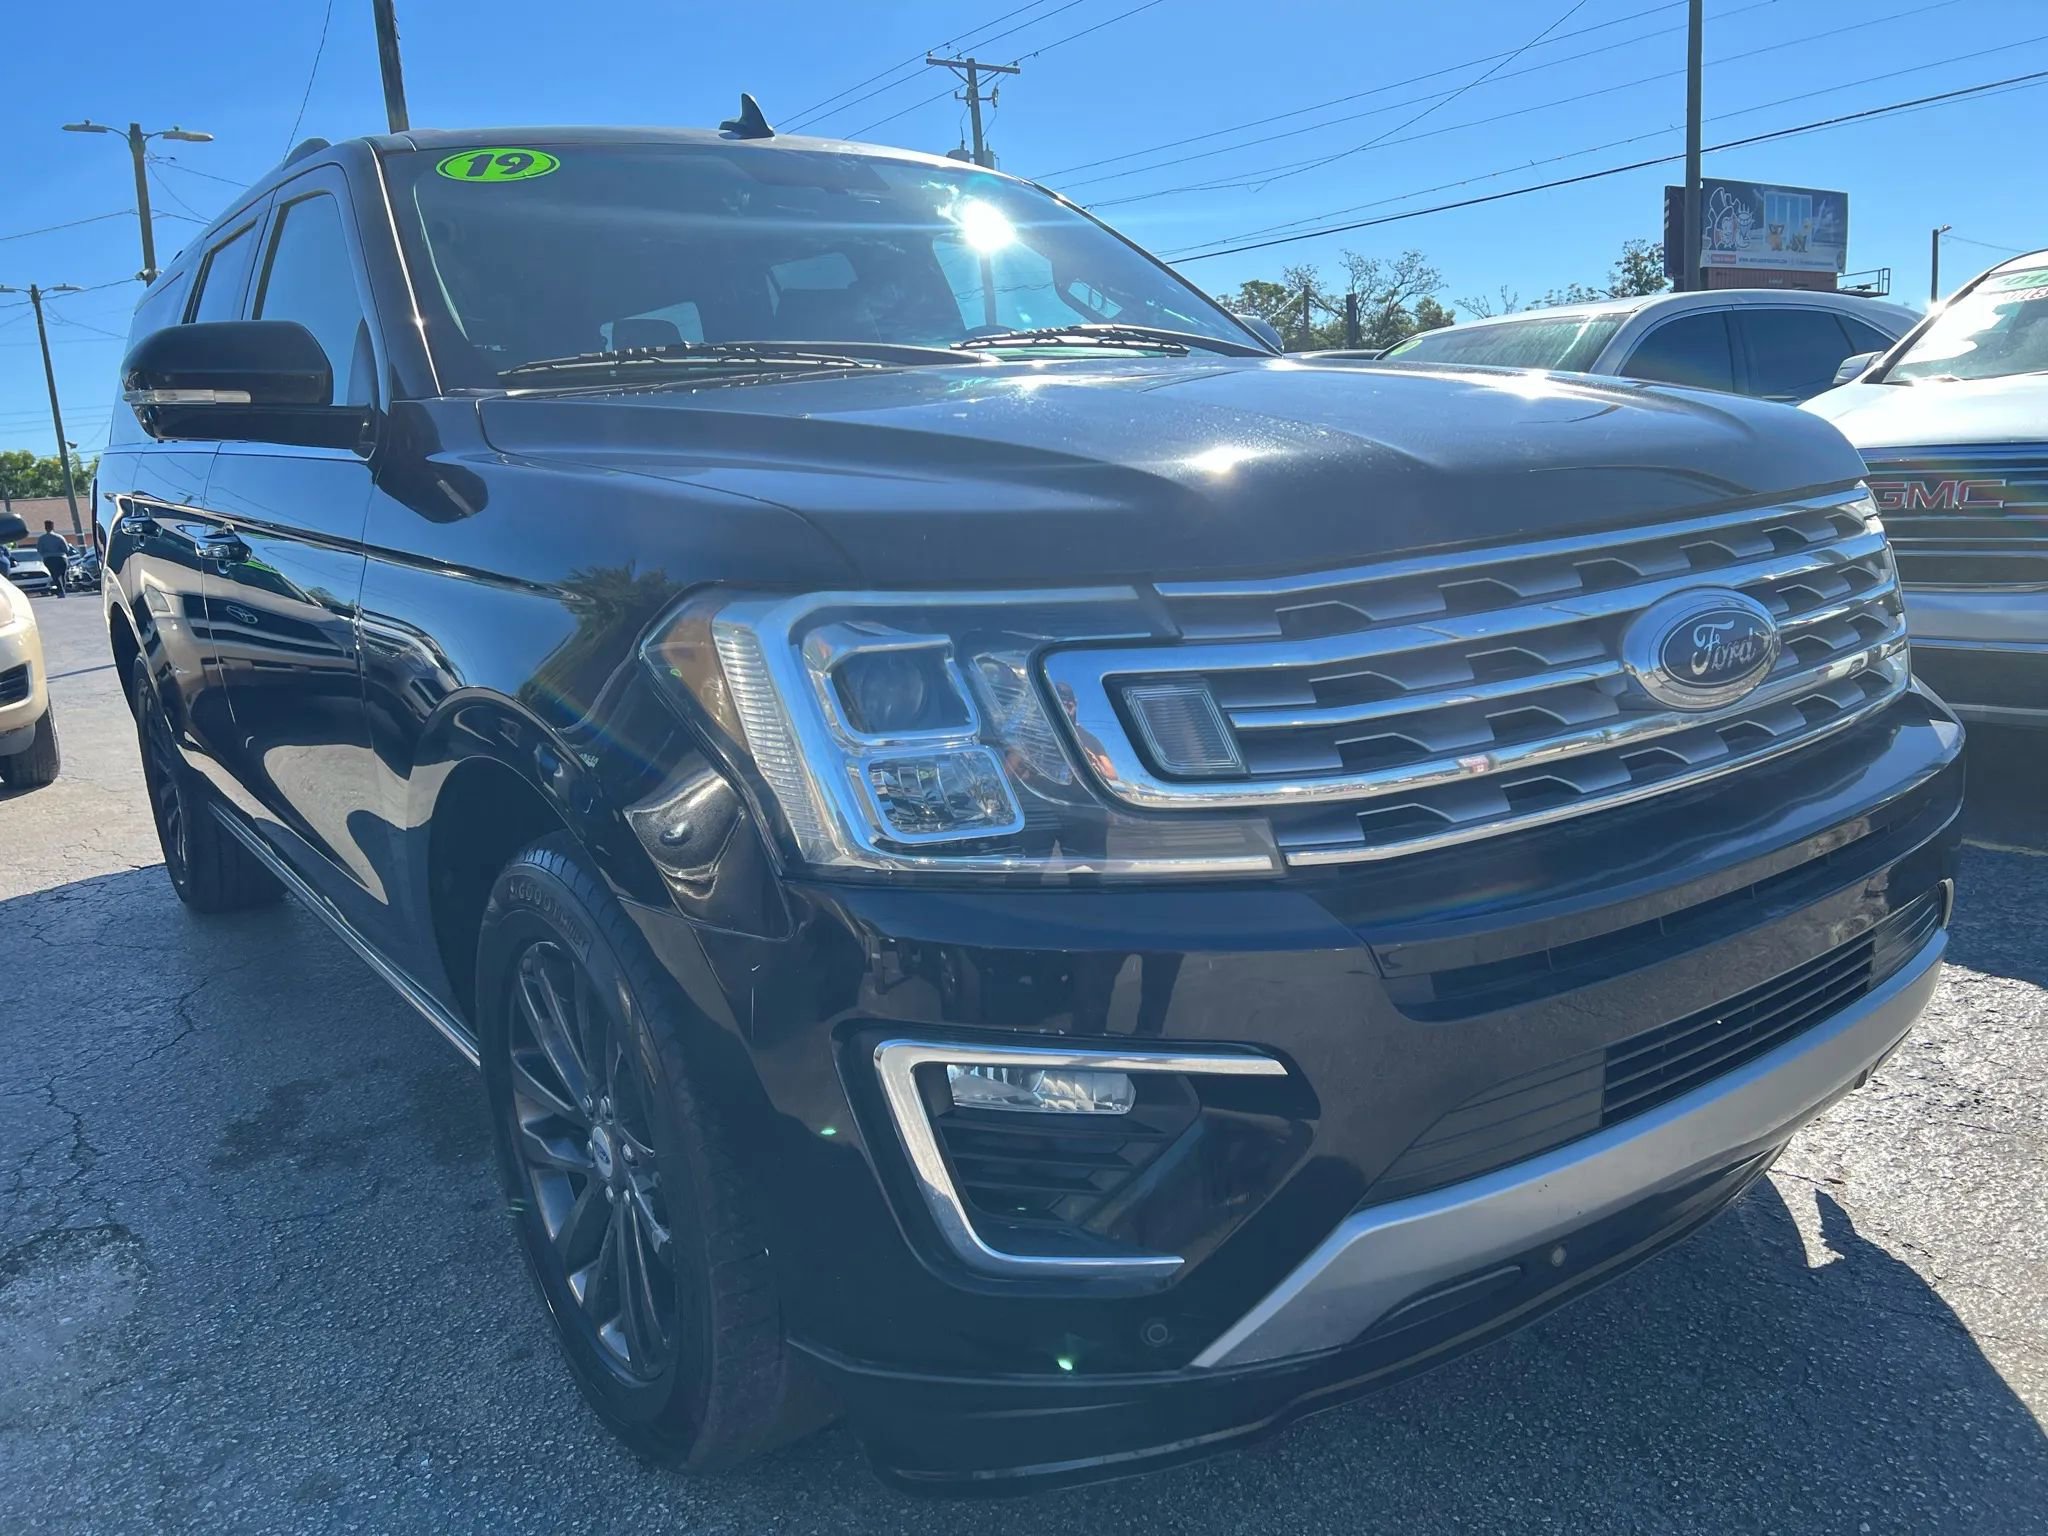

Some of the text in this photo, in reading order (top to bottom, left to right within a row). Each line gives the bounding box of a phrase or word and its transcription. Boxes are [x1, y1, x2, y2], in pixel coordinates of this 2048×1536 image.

[465, 152, 535, 177] 19
[1869, 478, 2007, 510] GMC
[1690, 619, 1757, 676] Ford
